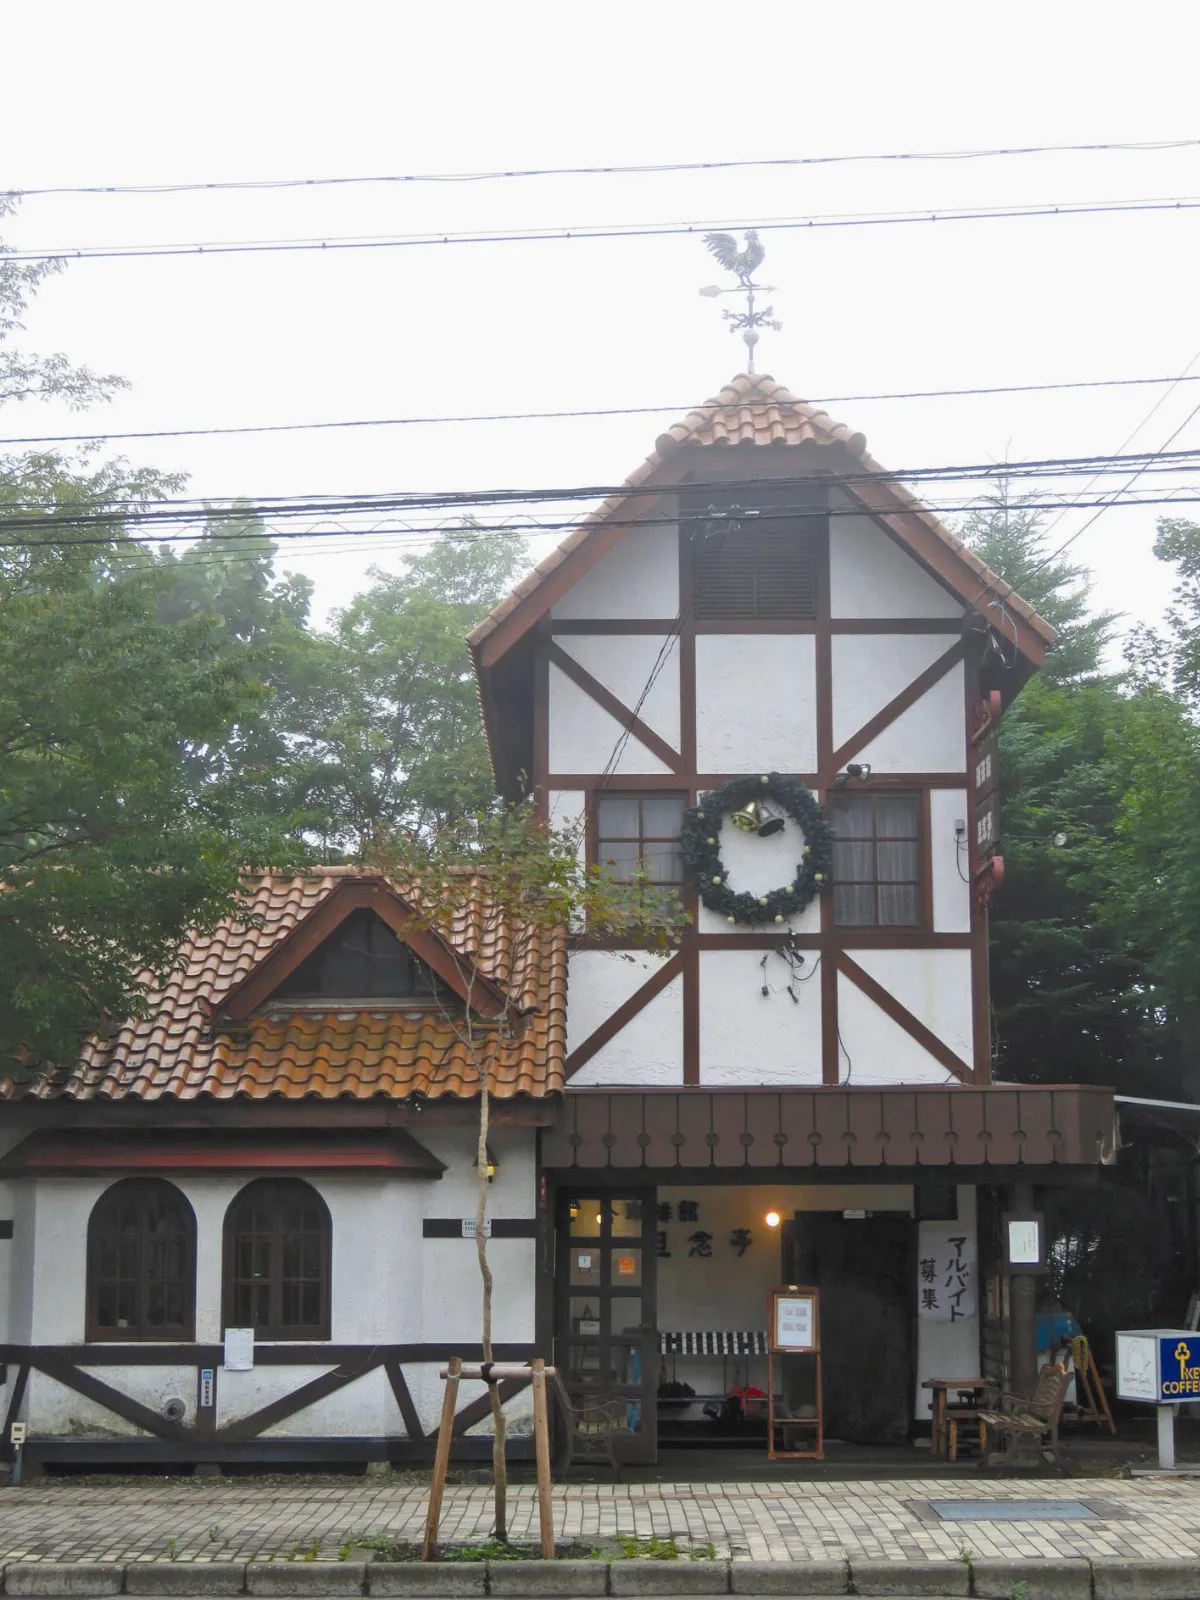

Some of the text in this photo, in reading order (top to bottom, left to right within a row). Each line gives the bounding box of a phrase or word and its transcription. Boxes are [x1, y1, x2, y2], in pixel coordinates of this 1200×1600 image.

[919, 1257, 940, 1310] 募集
[944, 1236, 970, 1323] アルバイト
[1162, 1381, 1200, 1395] COFFE
[1184, 1367, 1200, 1380] KE
